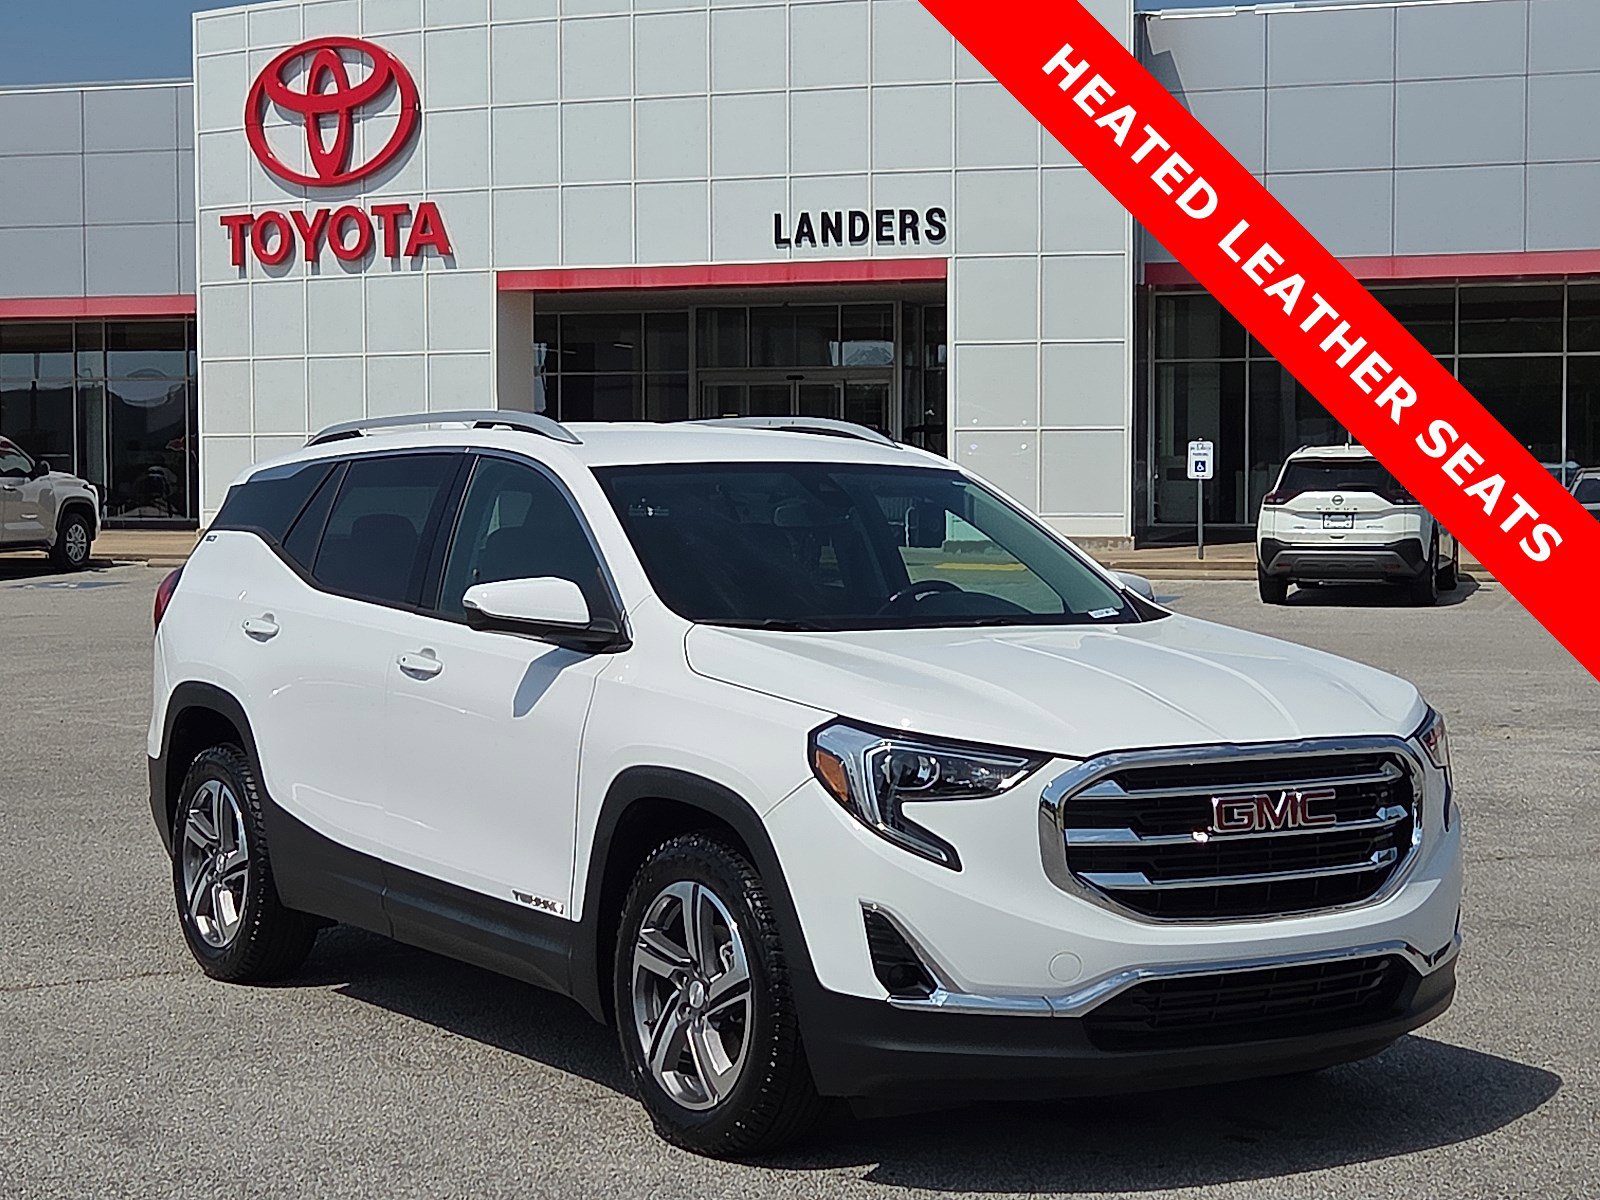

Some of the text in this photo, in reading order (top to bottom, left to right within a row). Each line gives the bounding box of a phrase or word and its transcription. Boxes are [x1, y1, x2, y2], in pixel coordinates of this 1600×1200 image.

[220, 202, 453, 266] TOYOTA
[774, 207, 947, 247] LANDERS
[1212, 788, 1337, 833] GMC
